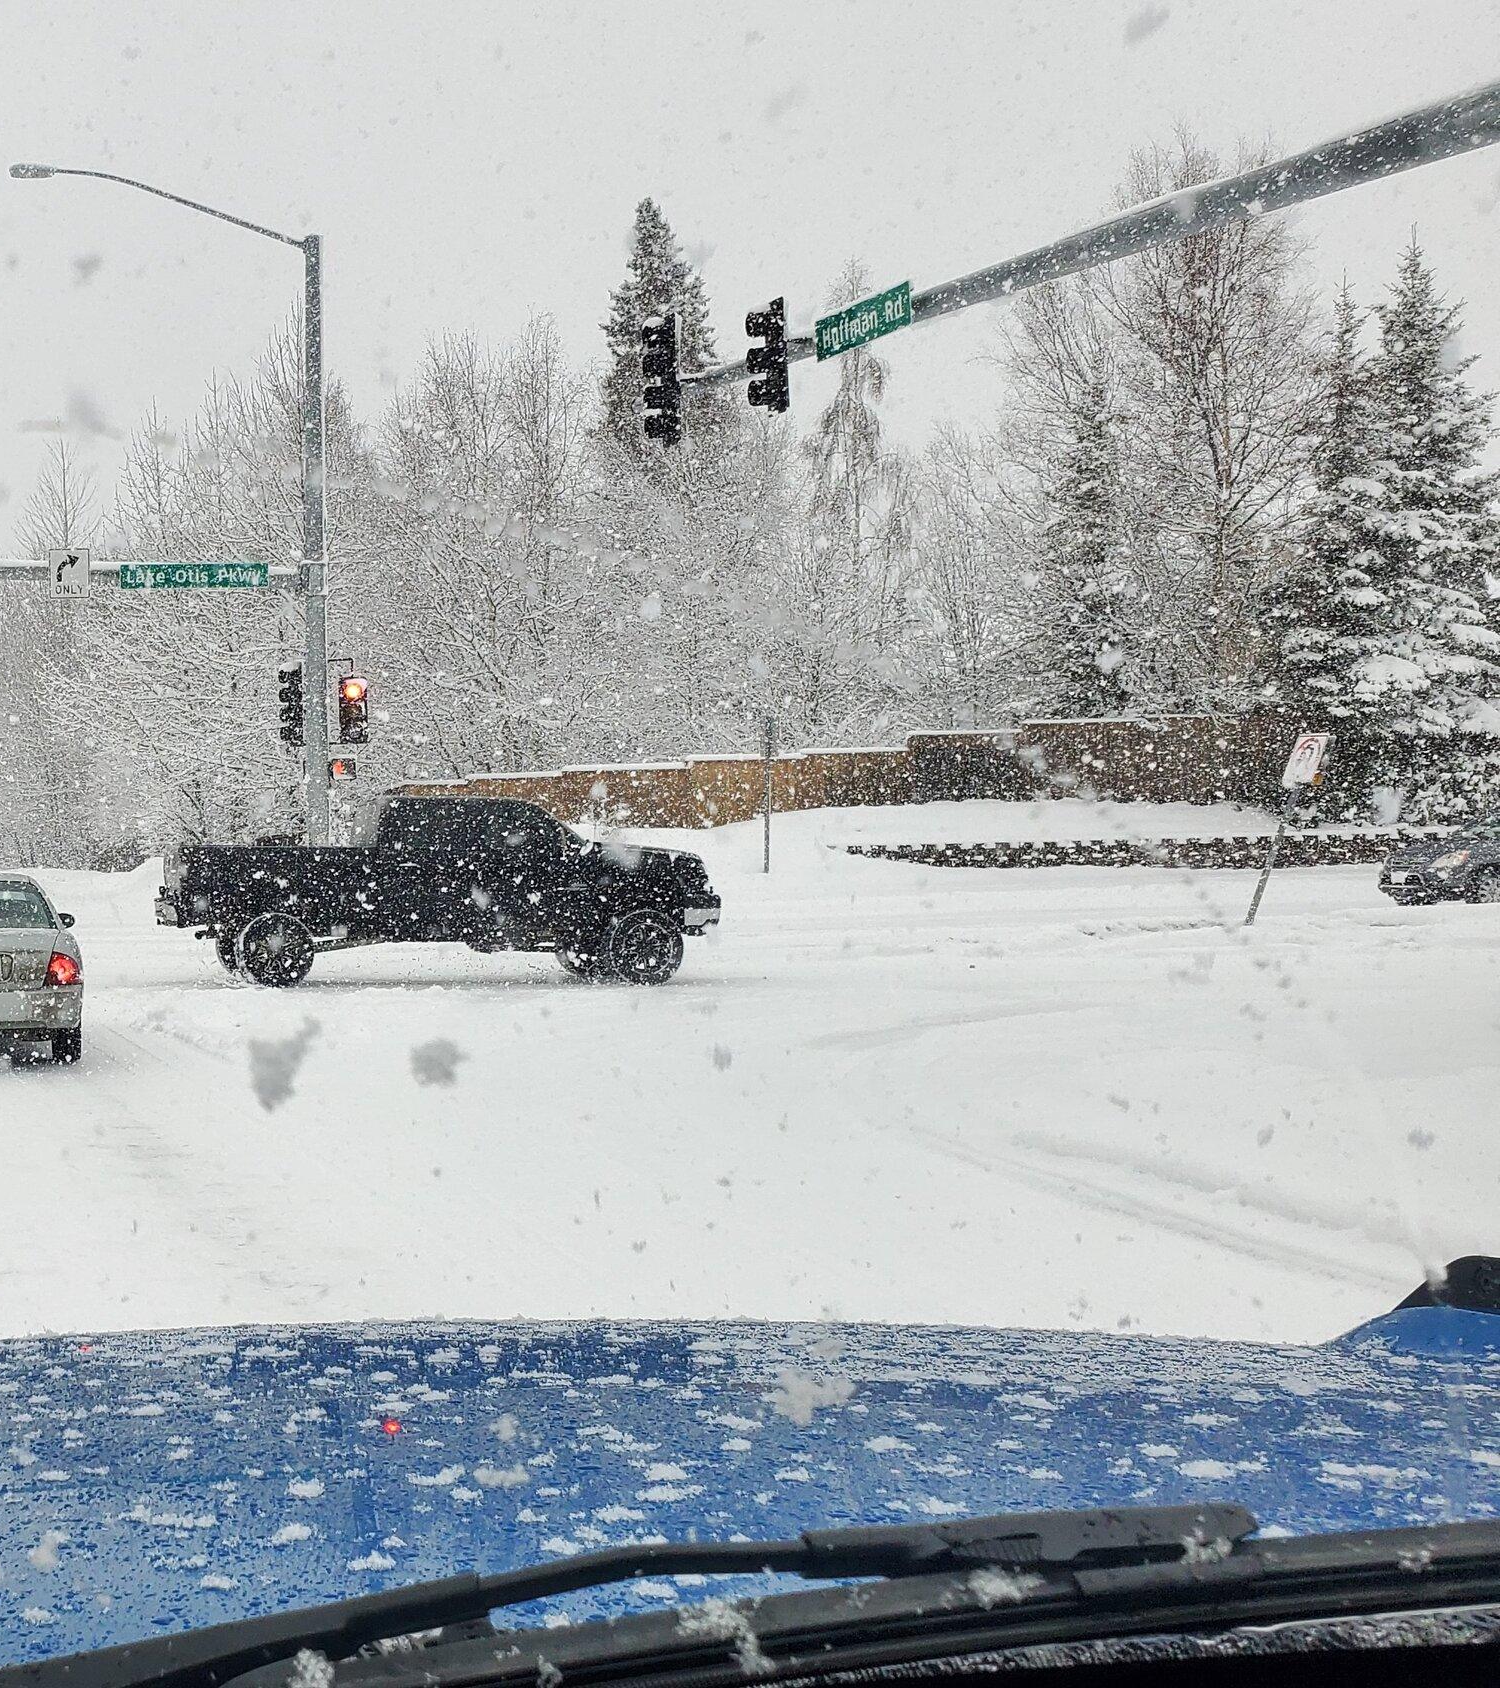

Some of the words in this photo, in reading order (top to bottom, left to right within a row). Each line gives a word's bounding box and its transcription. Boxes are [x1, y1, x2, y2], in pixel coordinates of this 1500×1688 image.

[822, 310, 879, 349] Hoffman
[884, 293, 904, 323] Rd
[126, 568, 166, 584] Lake
[175, 568, 209, 584] Otis
[55, 584, 83, 595] ONLY
